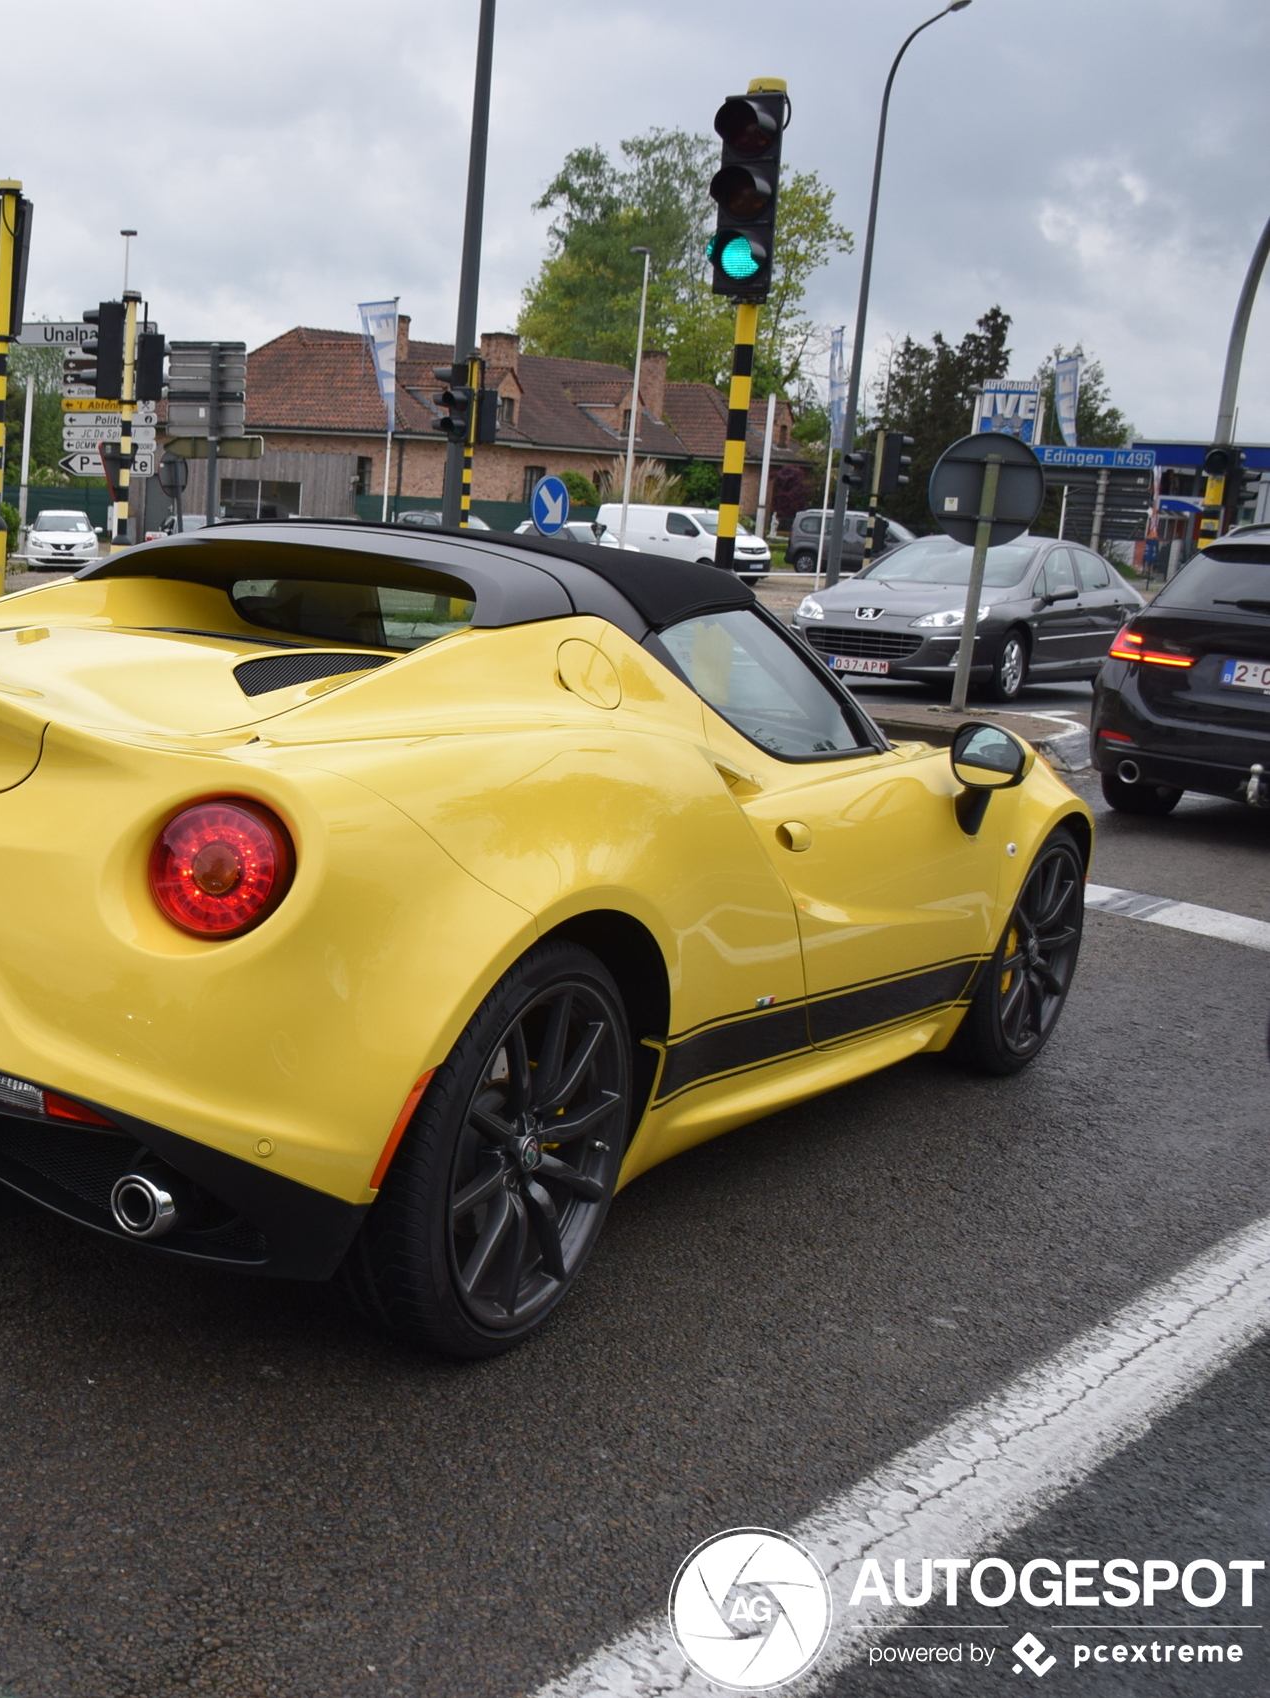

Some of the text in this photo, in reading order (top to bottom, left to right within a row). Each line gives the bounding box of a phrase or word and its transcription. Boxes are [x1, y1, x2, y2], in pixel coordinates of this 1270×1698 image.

[44, 326, 98, 345] Unalpa
[985, 381, 1039, 392] AUTOHANDEL
[982, 393, 1038, 419] IVE
[95, 415, 122, 425] Politi
[81, 428, 92, 438] JC
[94, 428, 105, 438] De
[75, 441, 97, 450] OCMW
[1044, 448, 1152, 467] Edingen N495
[835, 658, 887, 673] 037-APM
[1223, 673, 1232, 683] B
